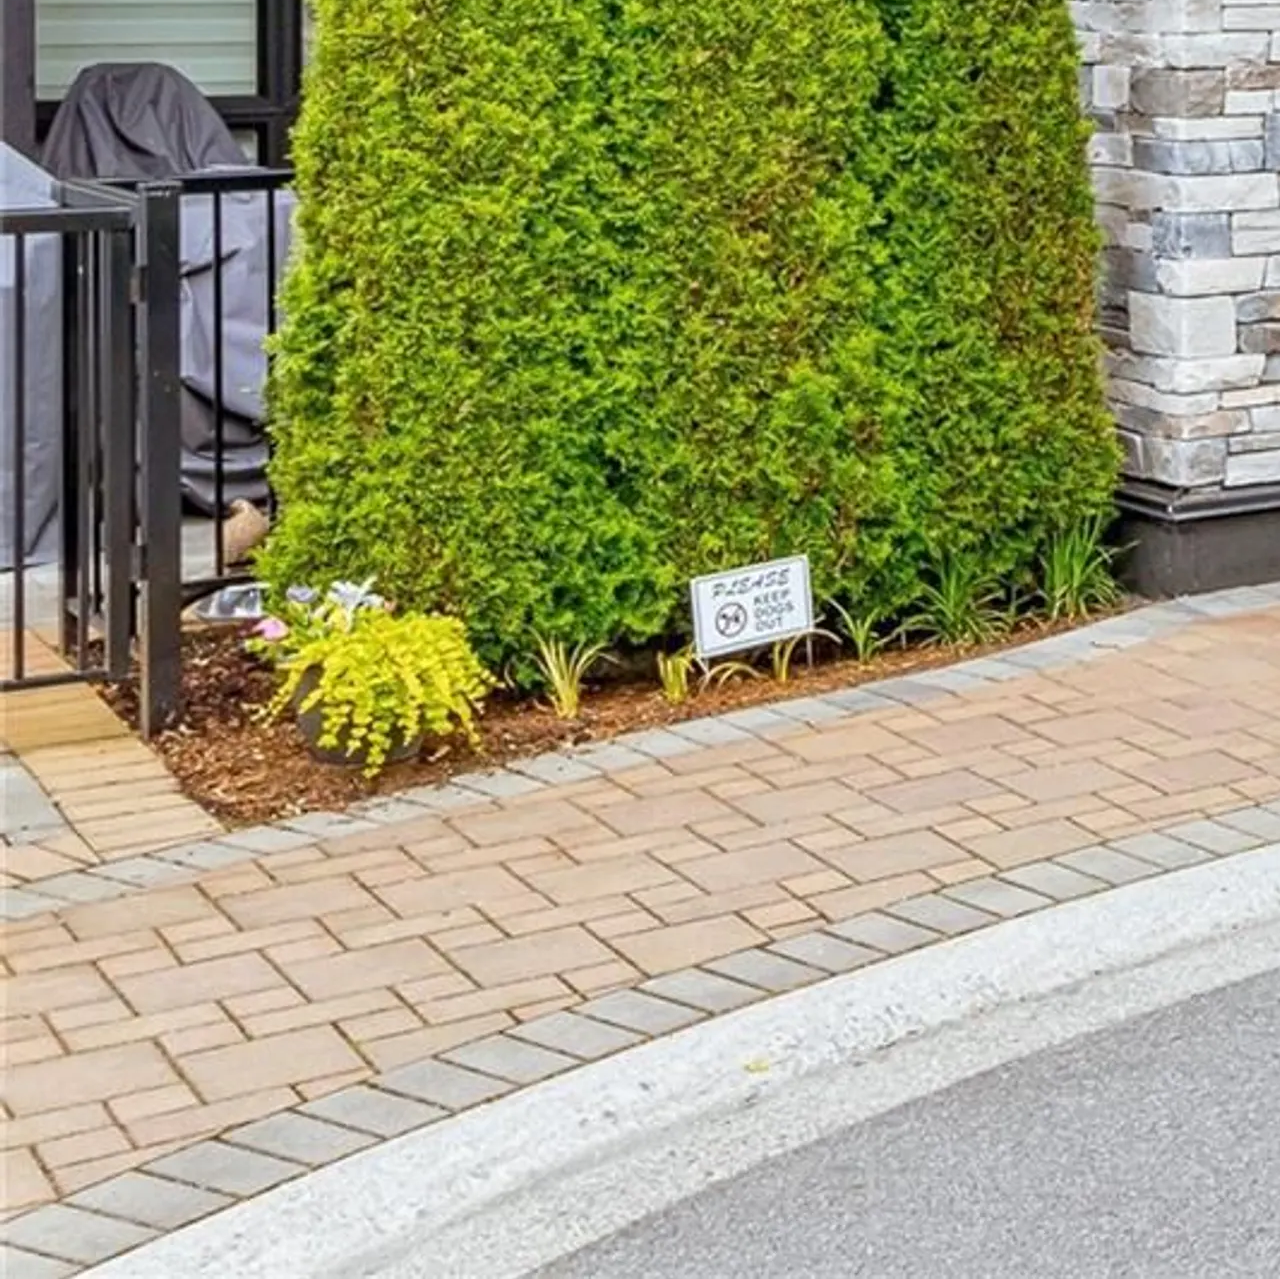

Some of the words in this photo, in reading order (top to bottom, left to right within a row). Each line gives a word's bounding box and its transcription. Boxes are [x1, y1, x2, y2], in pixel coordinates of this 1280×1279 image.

[711, 567, 791, 598] PLEASE
[753, 587, 790, 606] KEEP
[753, 599, 795, 619] DOGS
[755, 615, 783, 633] OUT
